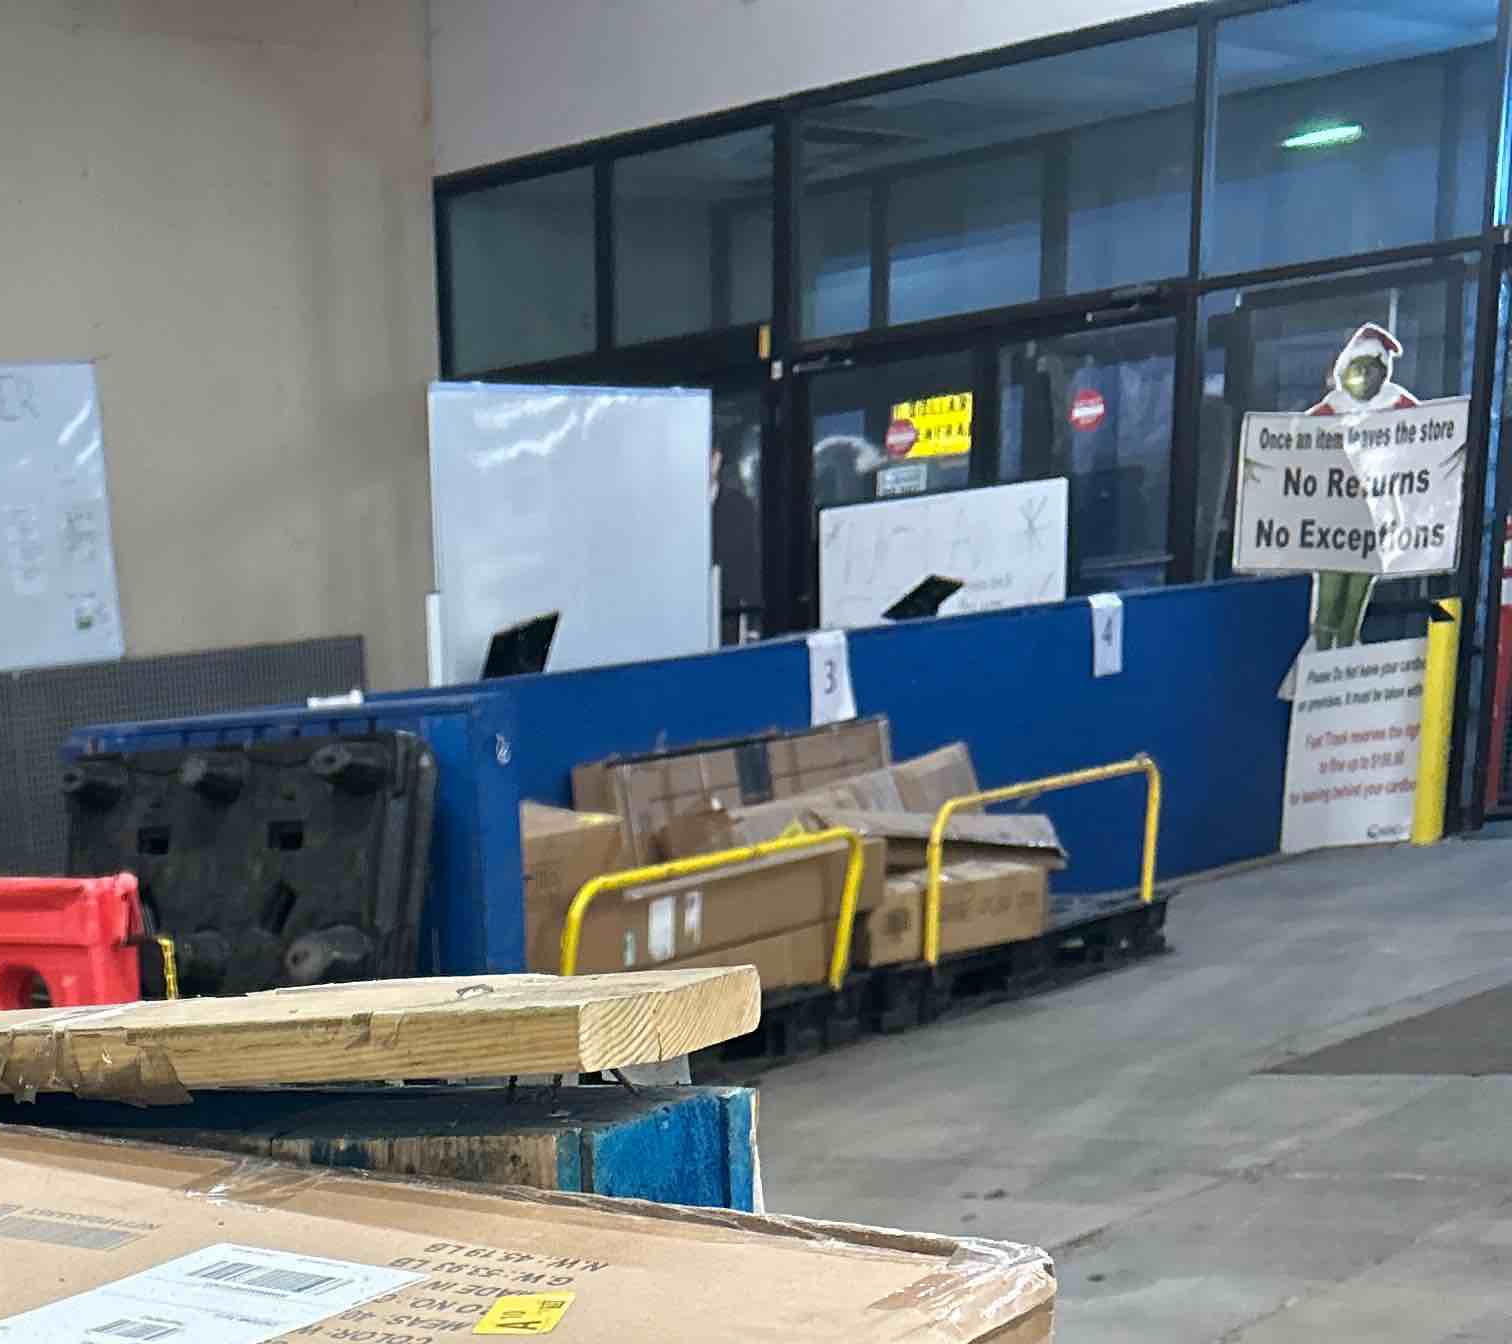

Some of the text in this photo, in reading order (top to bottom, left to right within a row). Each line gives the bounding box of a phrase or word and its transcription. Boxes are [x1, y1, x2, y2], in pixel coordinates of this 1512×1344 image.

[1259, 427, 1293, 450] Once
[1296, 431, 1312, 450] an
[1315, 426, 1344, 451] item
[1394, 419, 1416, 443] the
[1419, 417, 1455, 442] store
[1283, 467, 1317, 497] No
[1255, 519, 1445, 560] No Exceptions
[1101, 618, 1113, 647] 4
[823, 660, 834, 694] 3
[423, 1241, 466, 1254] LB
[389, 1256, 431, 1270] LB
[423, 1279, 457, 1291] IN
[496, 1318, 543, 1331] A
